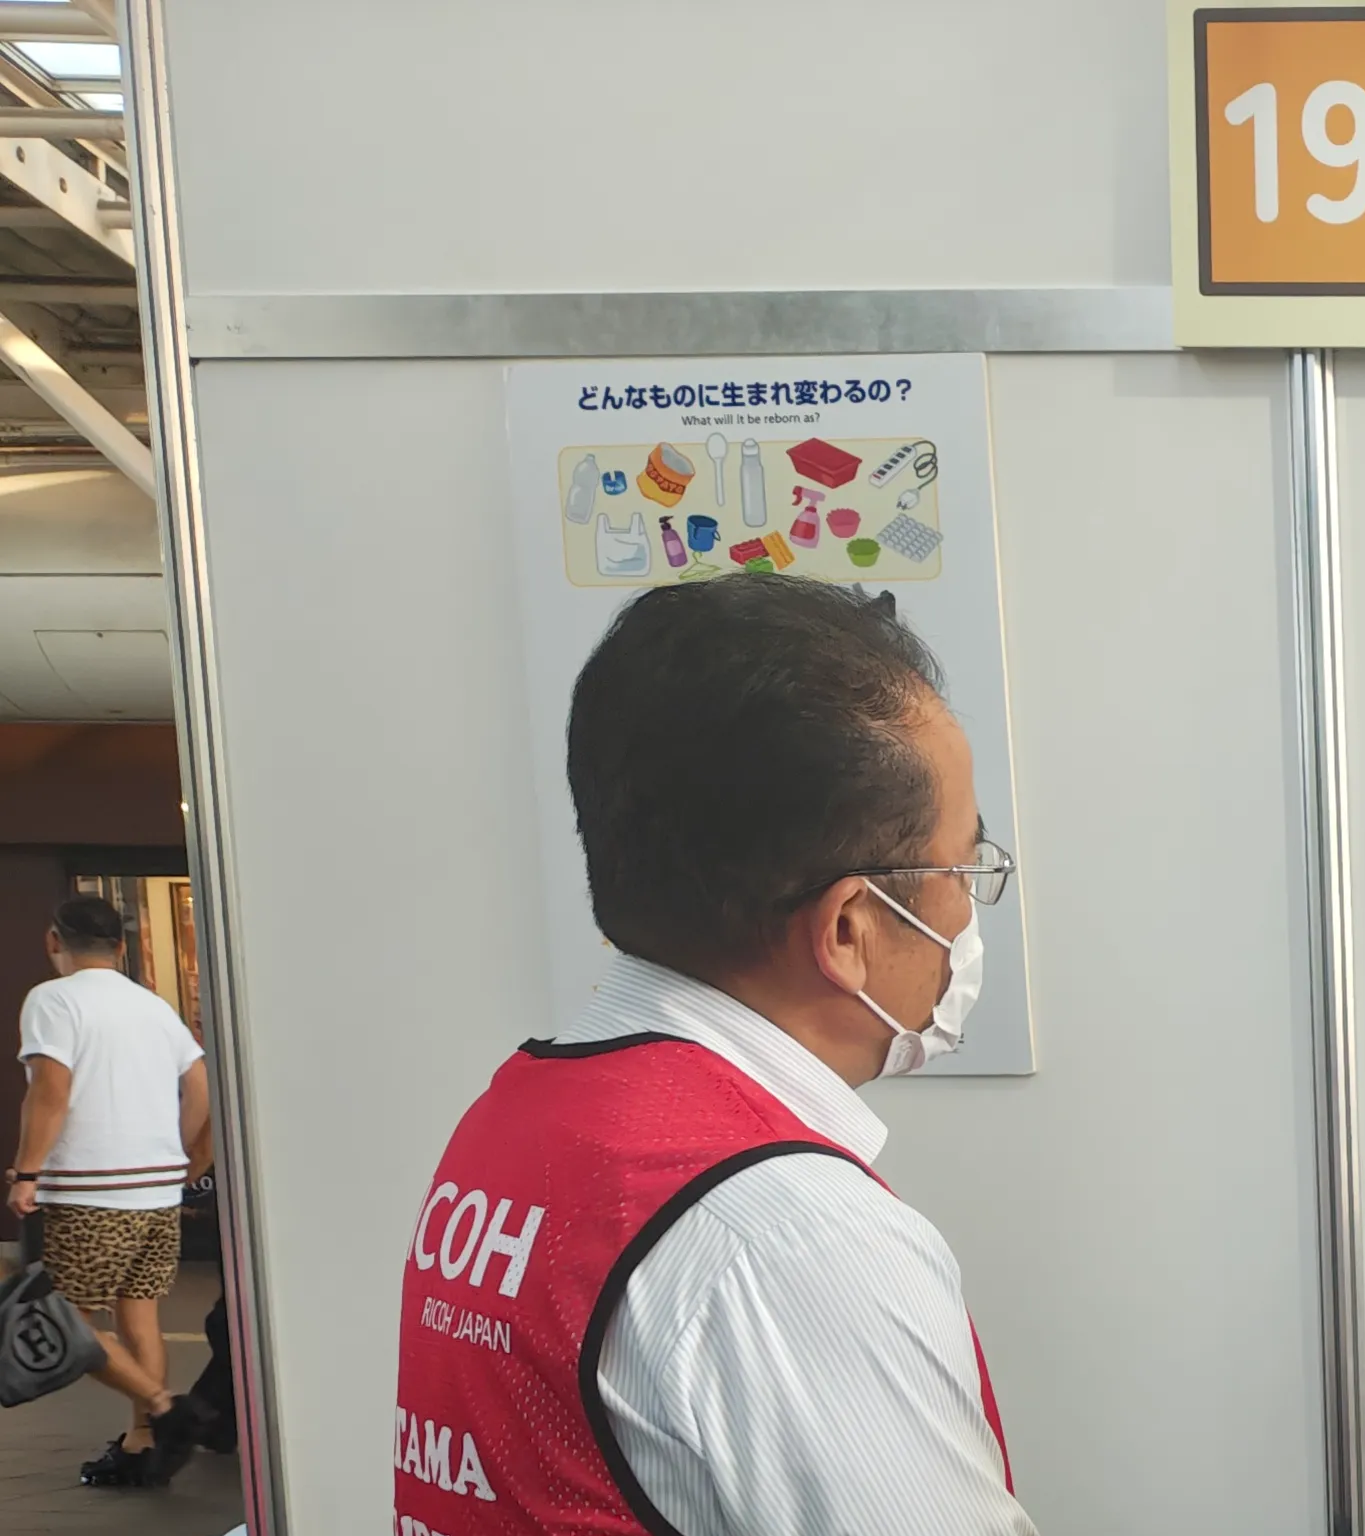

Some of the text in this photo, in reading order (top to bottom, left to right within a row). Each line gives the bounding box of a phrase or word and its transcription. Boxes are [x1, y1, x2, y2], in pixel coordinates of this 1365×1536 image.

[577, 379, 912, 411] どんなものに生まれ変わるの？
[681, 412, 821, 428] What will it be reborn as?
[421, 1297, 511, 1354] RICOH JAPAN
